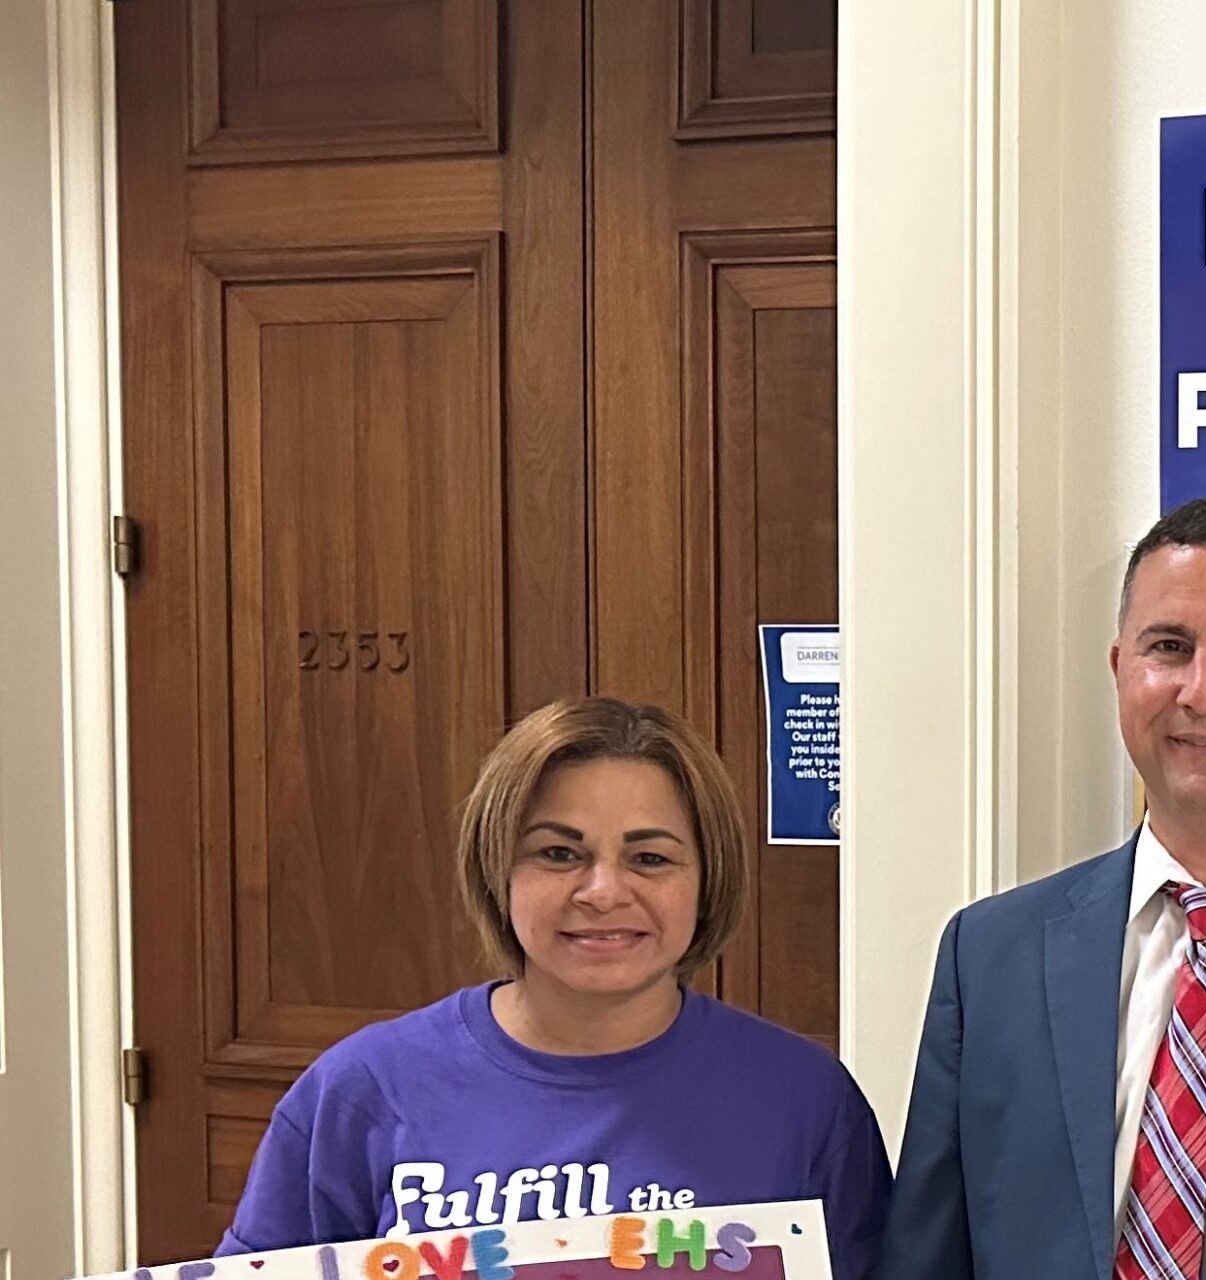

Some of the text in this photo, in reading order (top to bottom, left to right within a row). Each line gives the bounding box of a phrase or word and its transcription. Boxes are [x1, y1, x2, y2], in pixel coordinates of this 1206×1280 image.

[298, 630, 410, 673] 2353
[796, 650, 839, 662] DARREN
[800, 693, 832, 705] Please
[786, 706, 828, 718] member
[783, 718, 839, 730] check in wi
[792, 731, 811, 742] Our
[812, 731, 836, 742] staff
[790, 745, 810, 757] you
[788, 755, 813, 769] prior
[814, 756, 826, 767] to
[795, 767, 818, 779] with
[384, 1161, 696, 1239] Fulfill the
[609, 1215, 757, 1273] EHS
